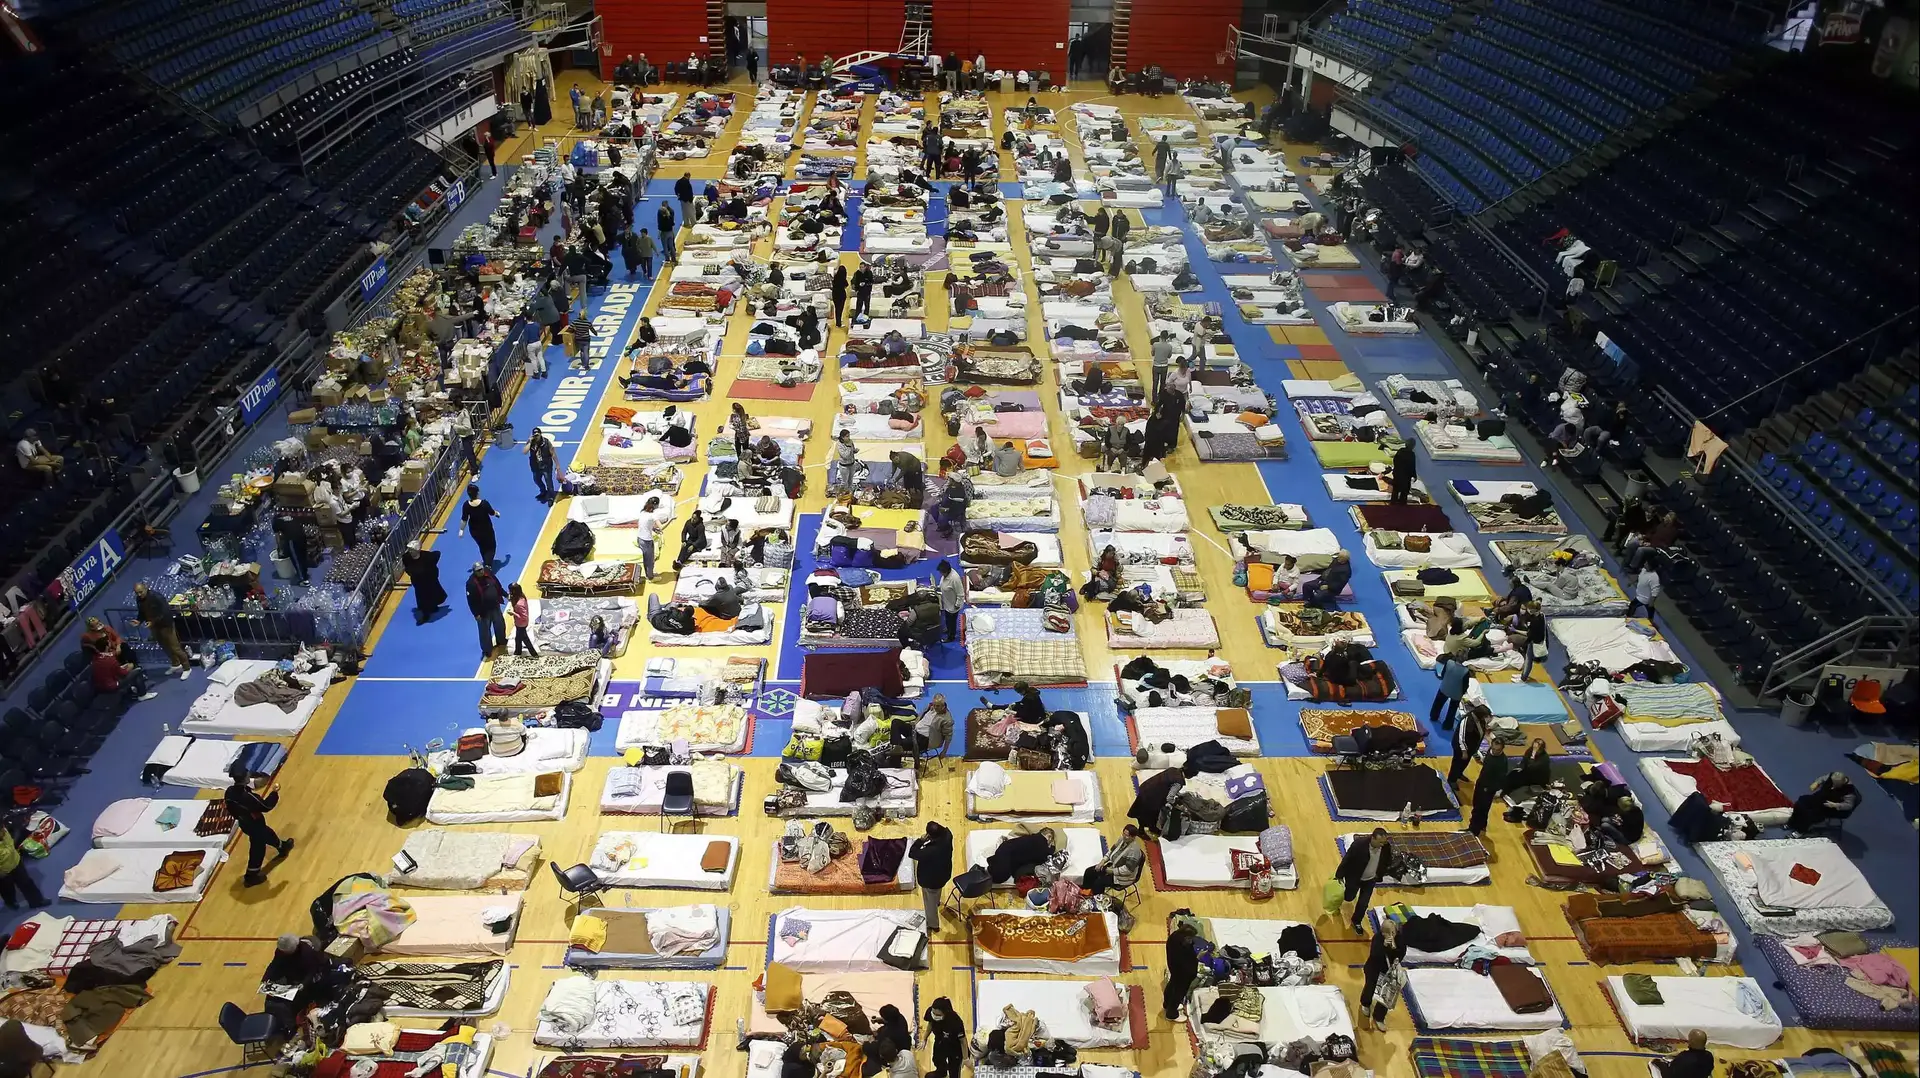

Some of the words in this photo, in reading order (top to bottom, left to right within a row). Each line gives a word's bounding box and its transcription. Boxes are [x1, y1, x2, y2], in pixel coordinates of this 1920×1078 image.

[362, 270, 376, 292] VIP
[241, 384, 261, 412] VIP
[72, 555, 98, 583] lava
[99, 538, 122, 578] A
